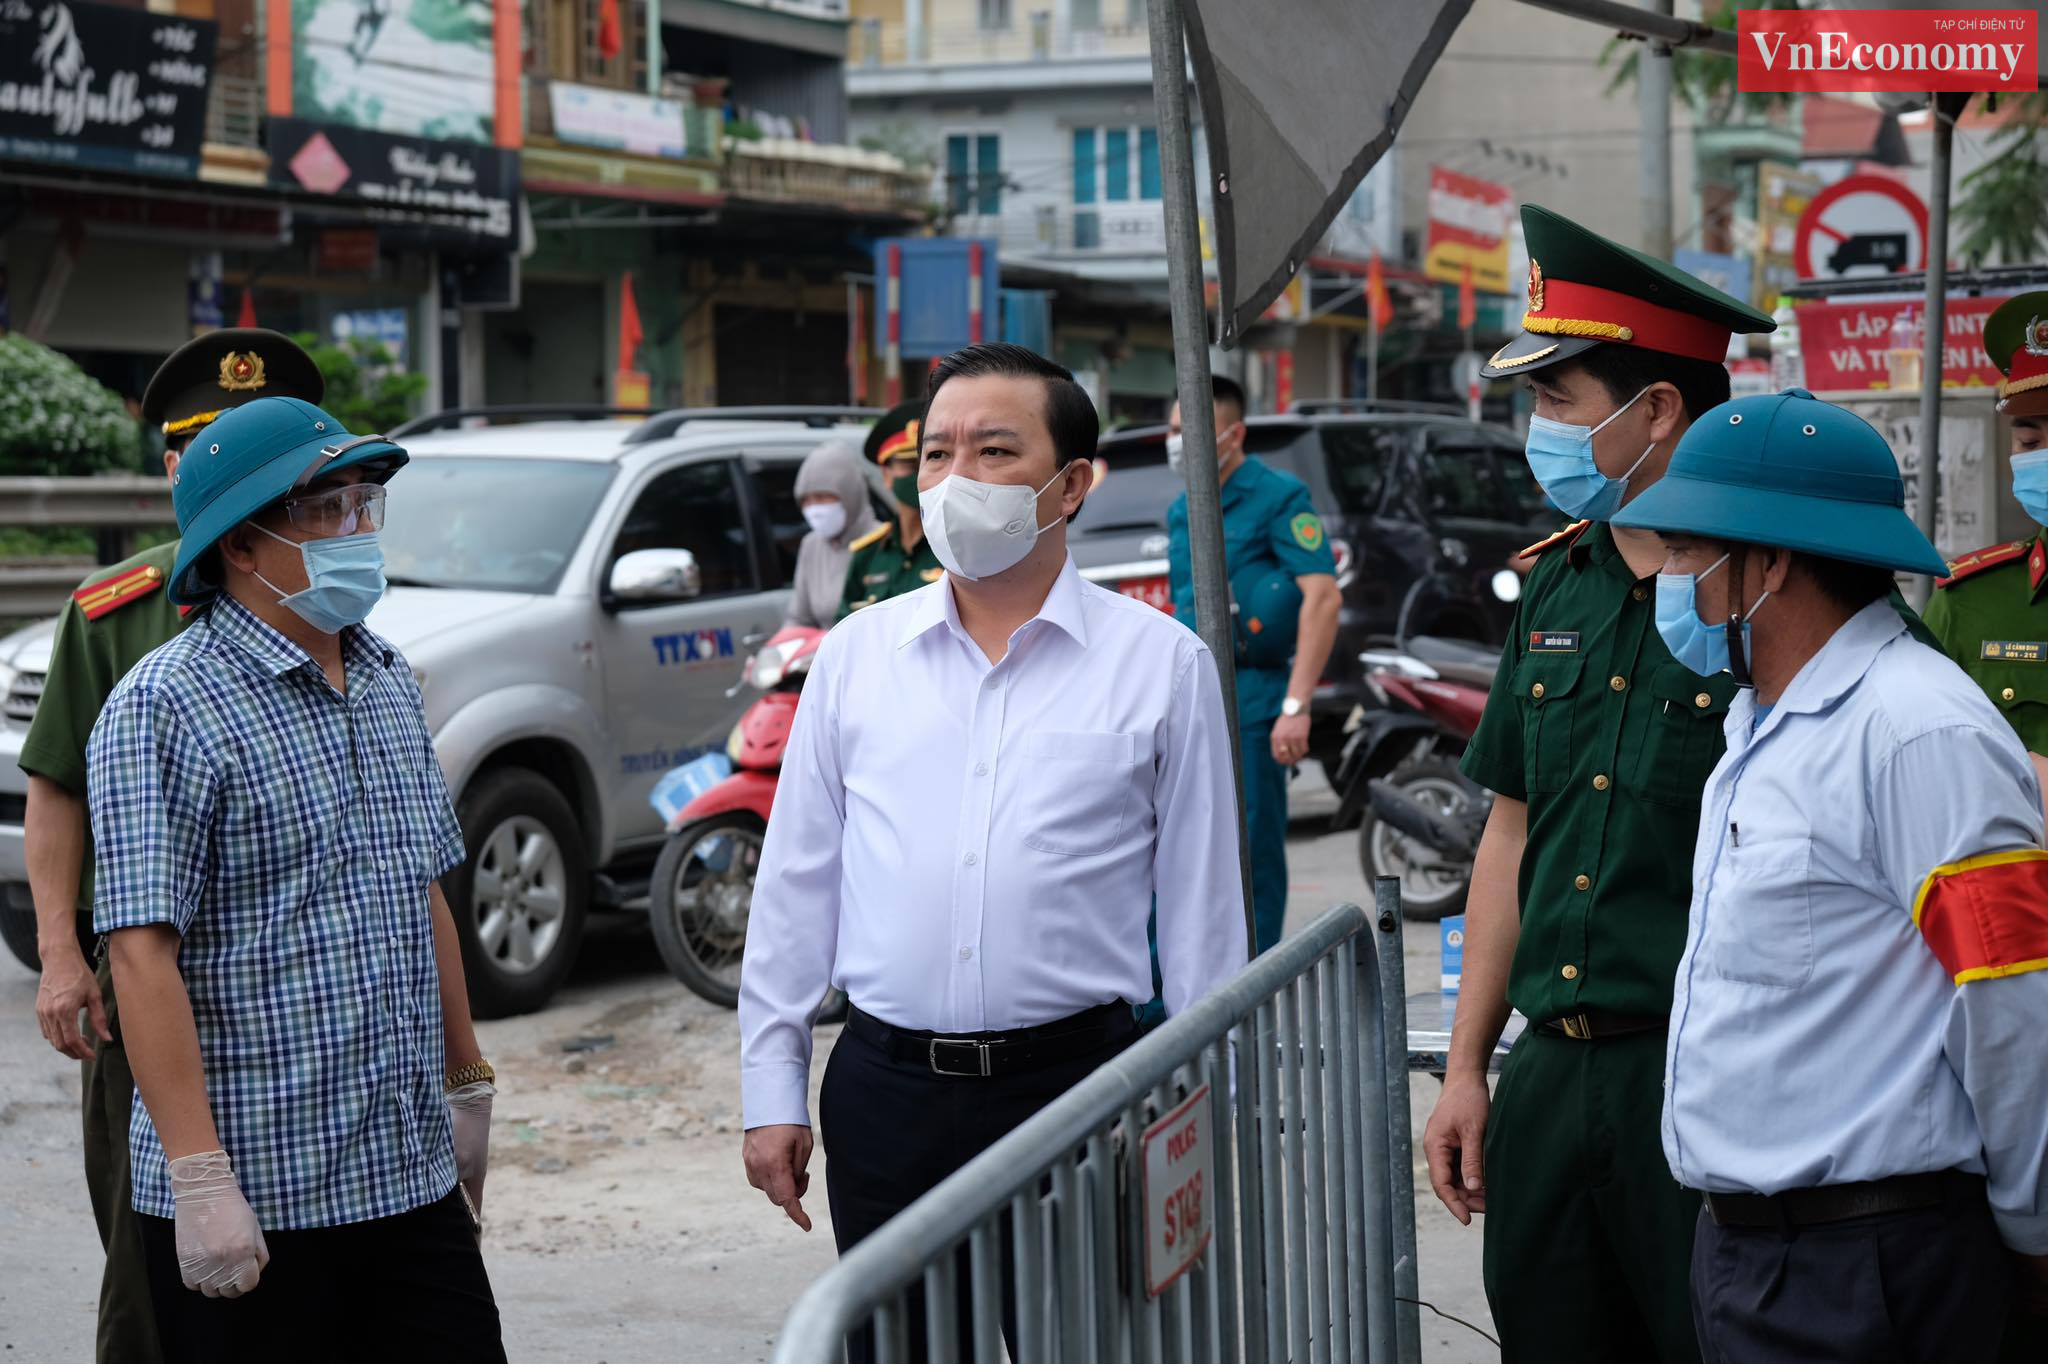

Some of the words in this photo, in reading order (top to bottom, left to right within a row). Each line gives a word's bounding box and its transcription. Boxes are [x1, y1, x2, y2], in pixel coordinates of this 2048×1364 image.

[1830, 348, 1866, 372] VÀ
[1167, 1118, 1197, 1167] POLICE
[1164, 1168, 1203, 1248] STOP
